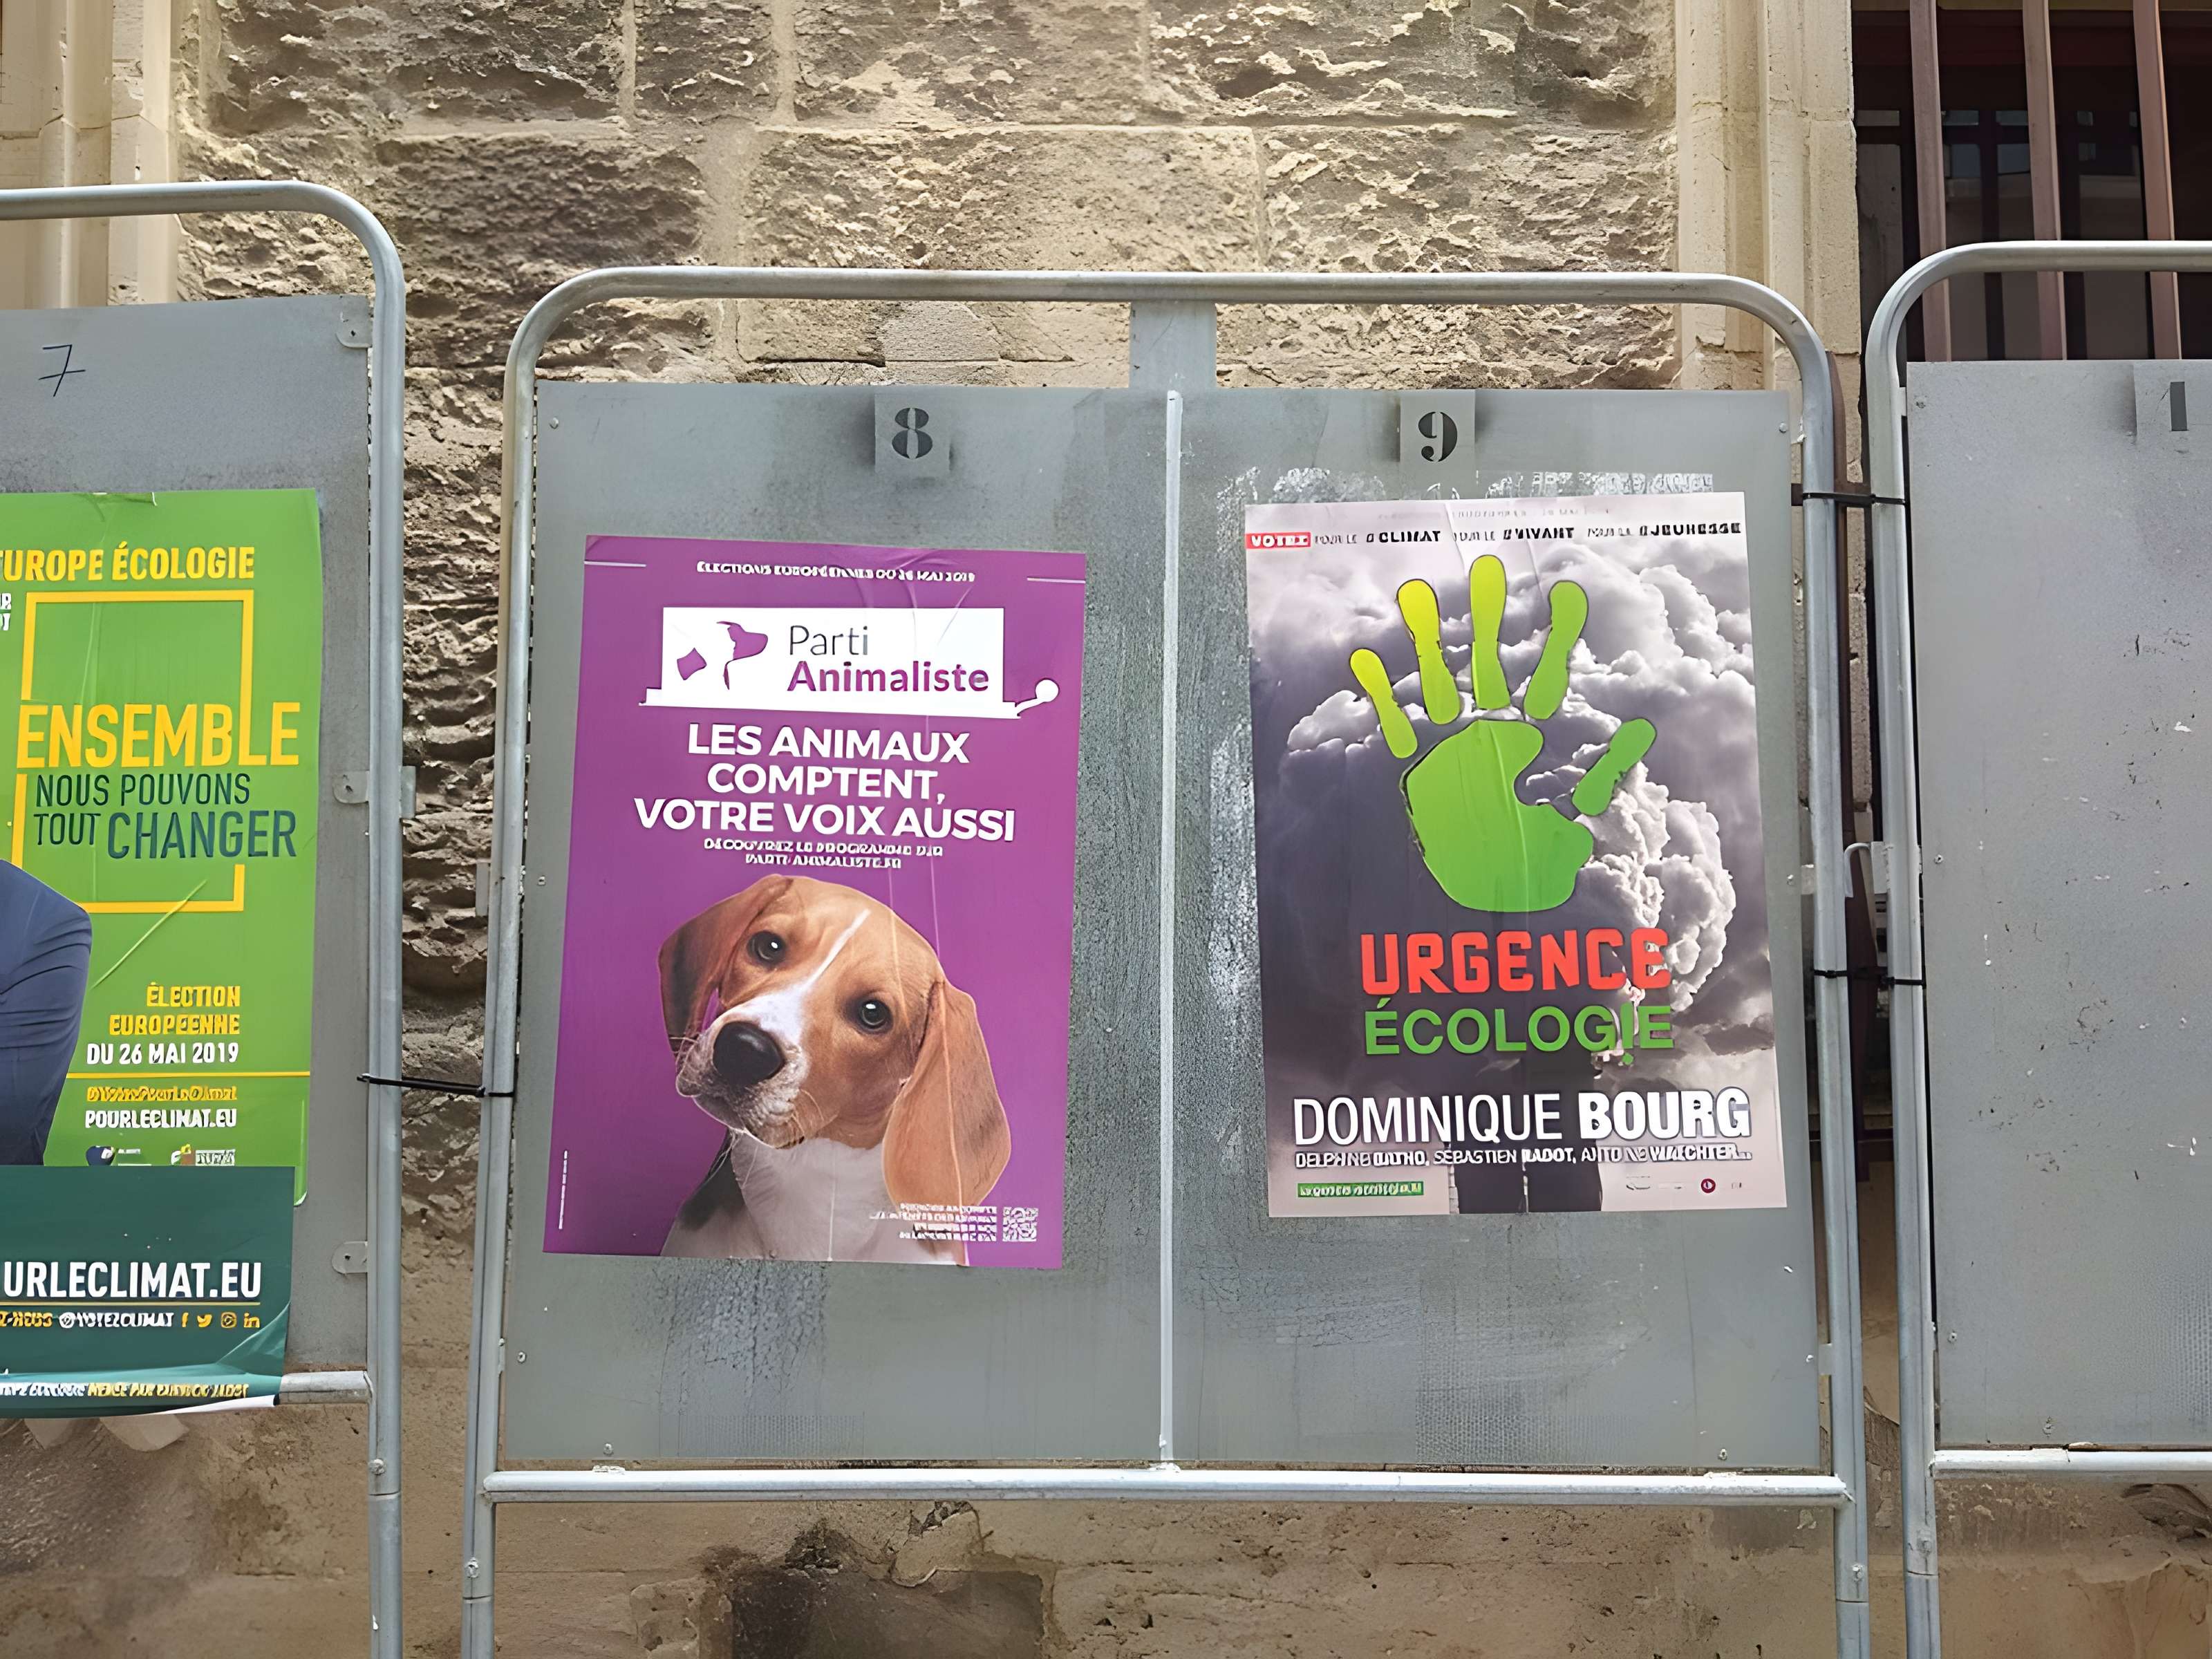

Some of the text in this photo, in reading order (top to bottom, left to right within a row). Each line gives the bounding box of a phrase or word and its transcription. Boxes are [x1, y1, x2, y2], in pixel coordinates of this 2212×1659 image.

[39, 344, 86, 397] 7
[892, 408, 933, 459] 8
[1418, 411, 1458, 462] 9
[0, 541, 255, 581] UROPE ÉCOLOGIE
[789, 625, 869, 655] Parti
[787, 661, 989, 692] Animaliste
[17, 702, 300, 768] ENSEMBLE
[688, 723, 970, 763] LES ANIMAUX
[36, 772, 251, 807] NOUS POUVONS
[708, 762, 946, 803] COMPTENT,
[33, 809, 297, 859] TOUT CHANGER
[634, 798, 1015, 841] VOTRE VOIX AUSSI
[1360, 927, 1671, 995] URGENCE
[1364, 997, 1674, 1055] ÉCOLOGIE
[87, 1042, 239, 1065] DU 26 MAI 2019
[1293, 1087, 1752, 1145] DOMINIQUE BOURG
[3, 1261, 262, 1298] URLECLIMAT.EU
